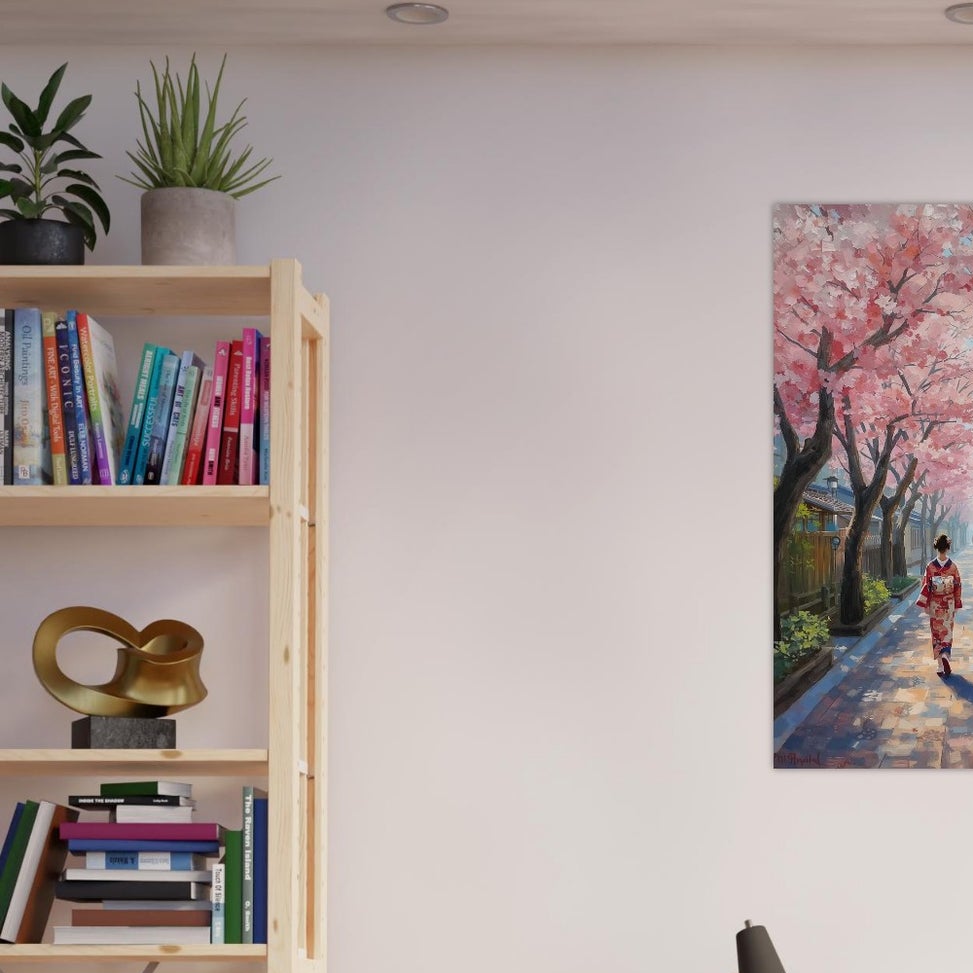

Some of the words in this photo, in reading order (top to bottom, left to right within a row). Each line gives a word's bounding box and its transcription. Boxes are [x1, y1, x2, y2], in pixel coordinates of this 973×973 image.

[21, 325, 32, 340] Oil
[19, 342, 32, 386] Paintings
[244, 816, 252, 849] Raven
[244, 850, 252, 881] Island
